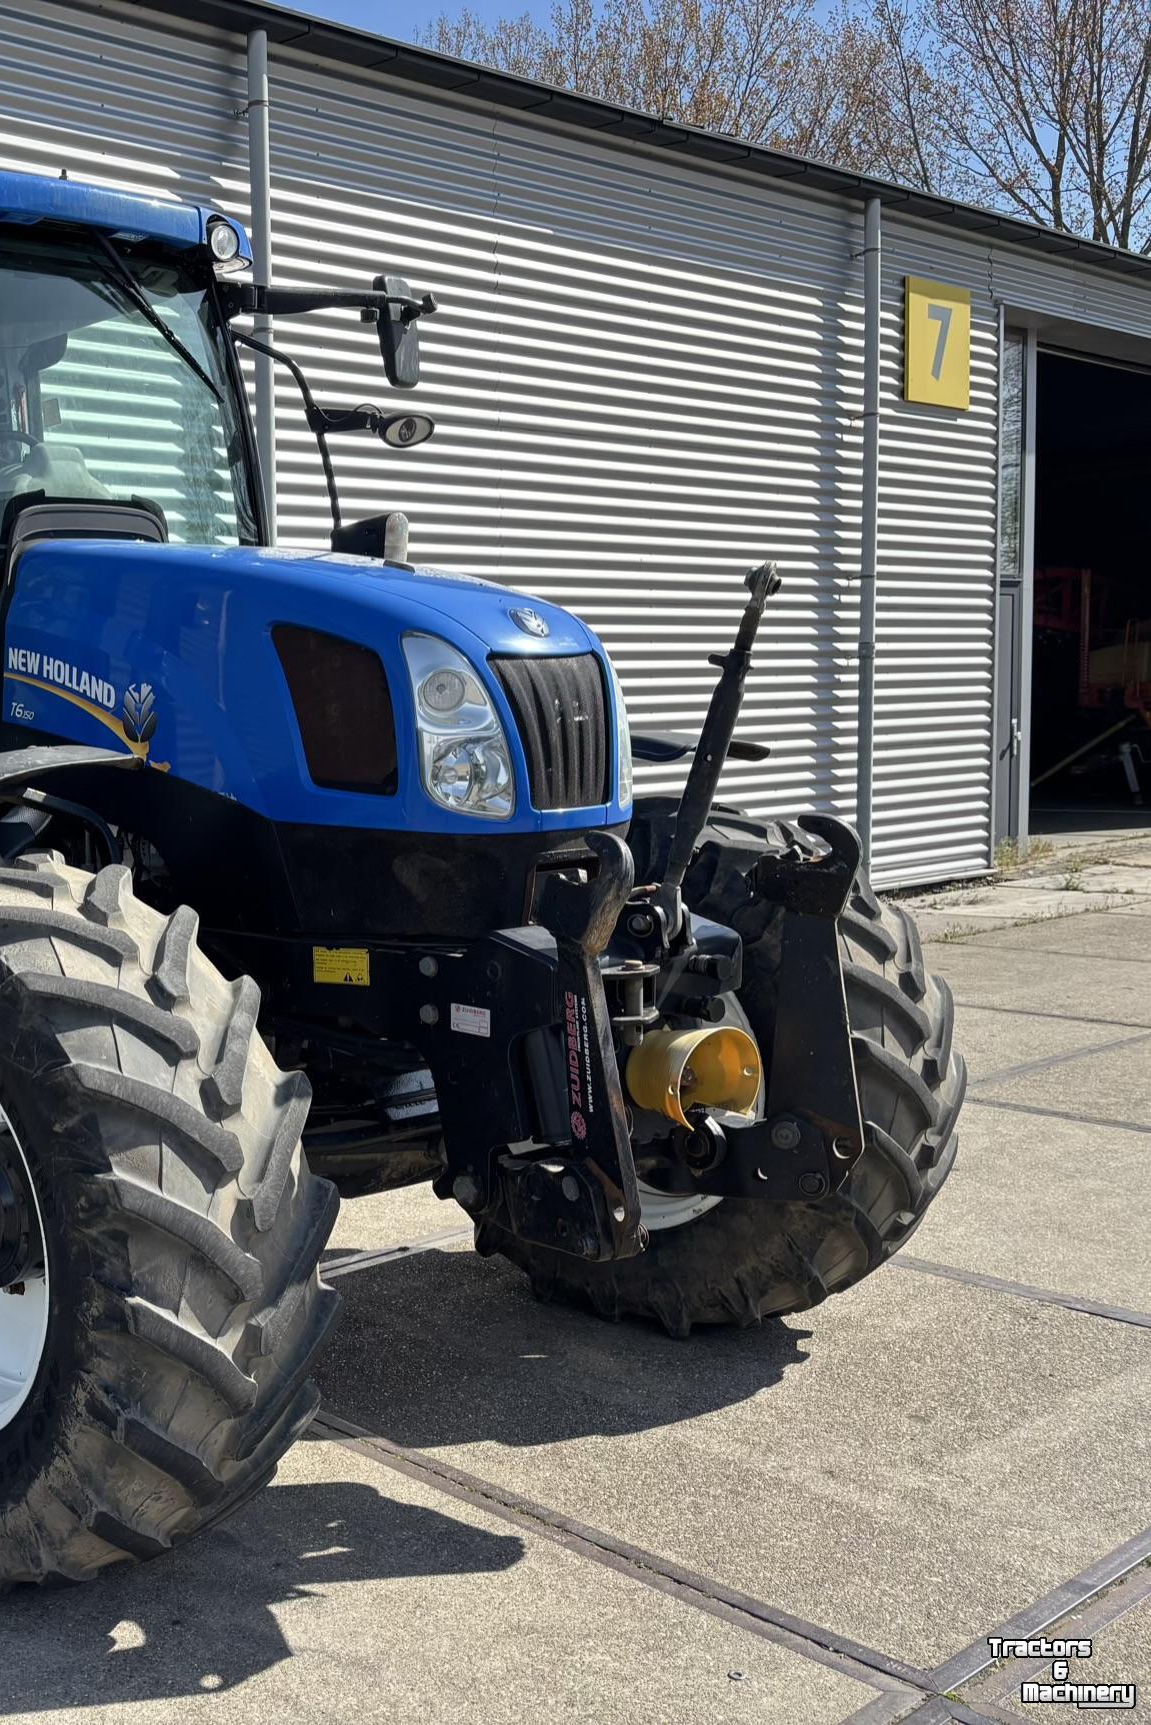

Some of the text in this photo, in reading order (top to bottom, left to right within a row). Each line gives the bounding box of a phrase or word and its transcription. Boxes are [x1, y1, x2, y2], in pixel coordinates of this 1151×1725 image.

[927, 303, 953, 382] 7
[8, 647, 116, 709] NEW HOLLAND
[564, 991, 582, 1109] ZUIDBERG
